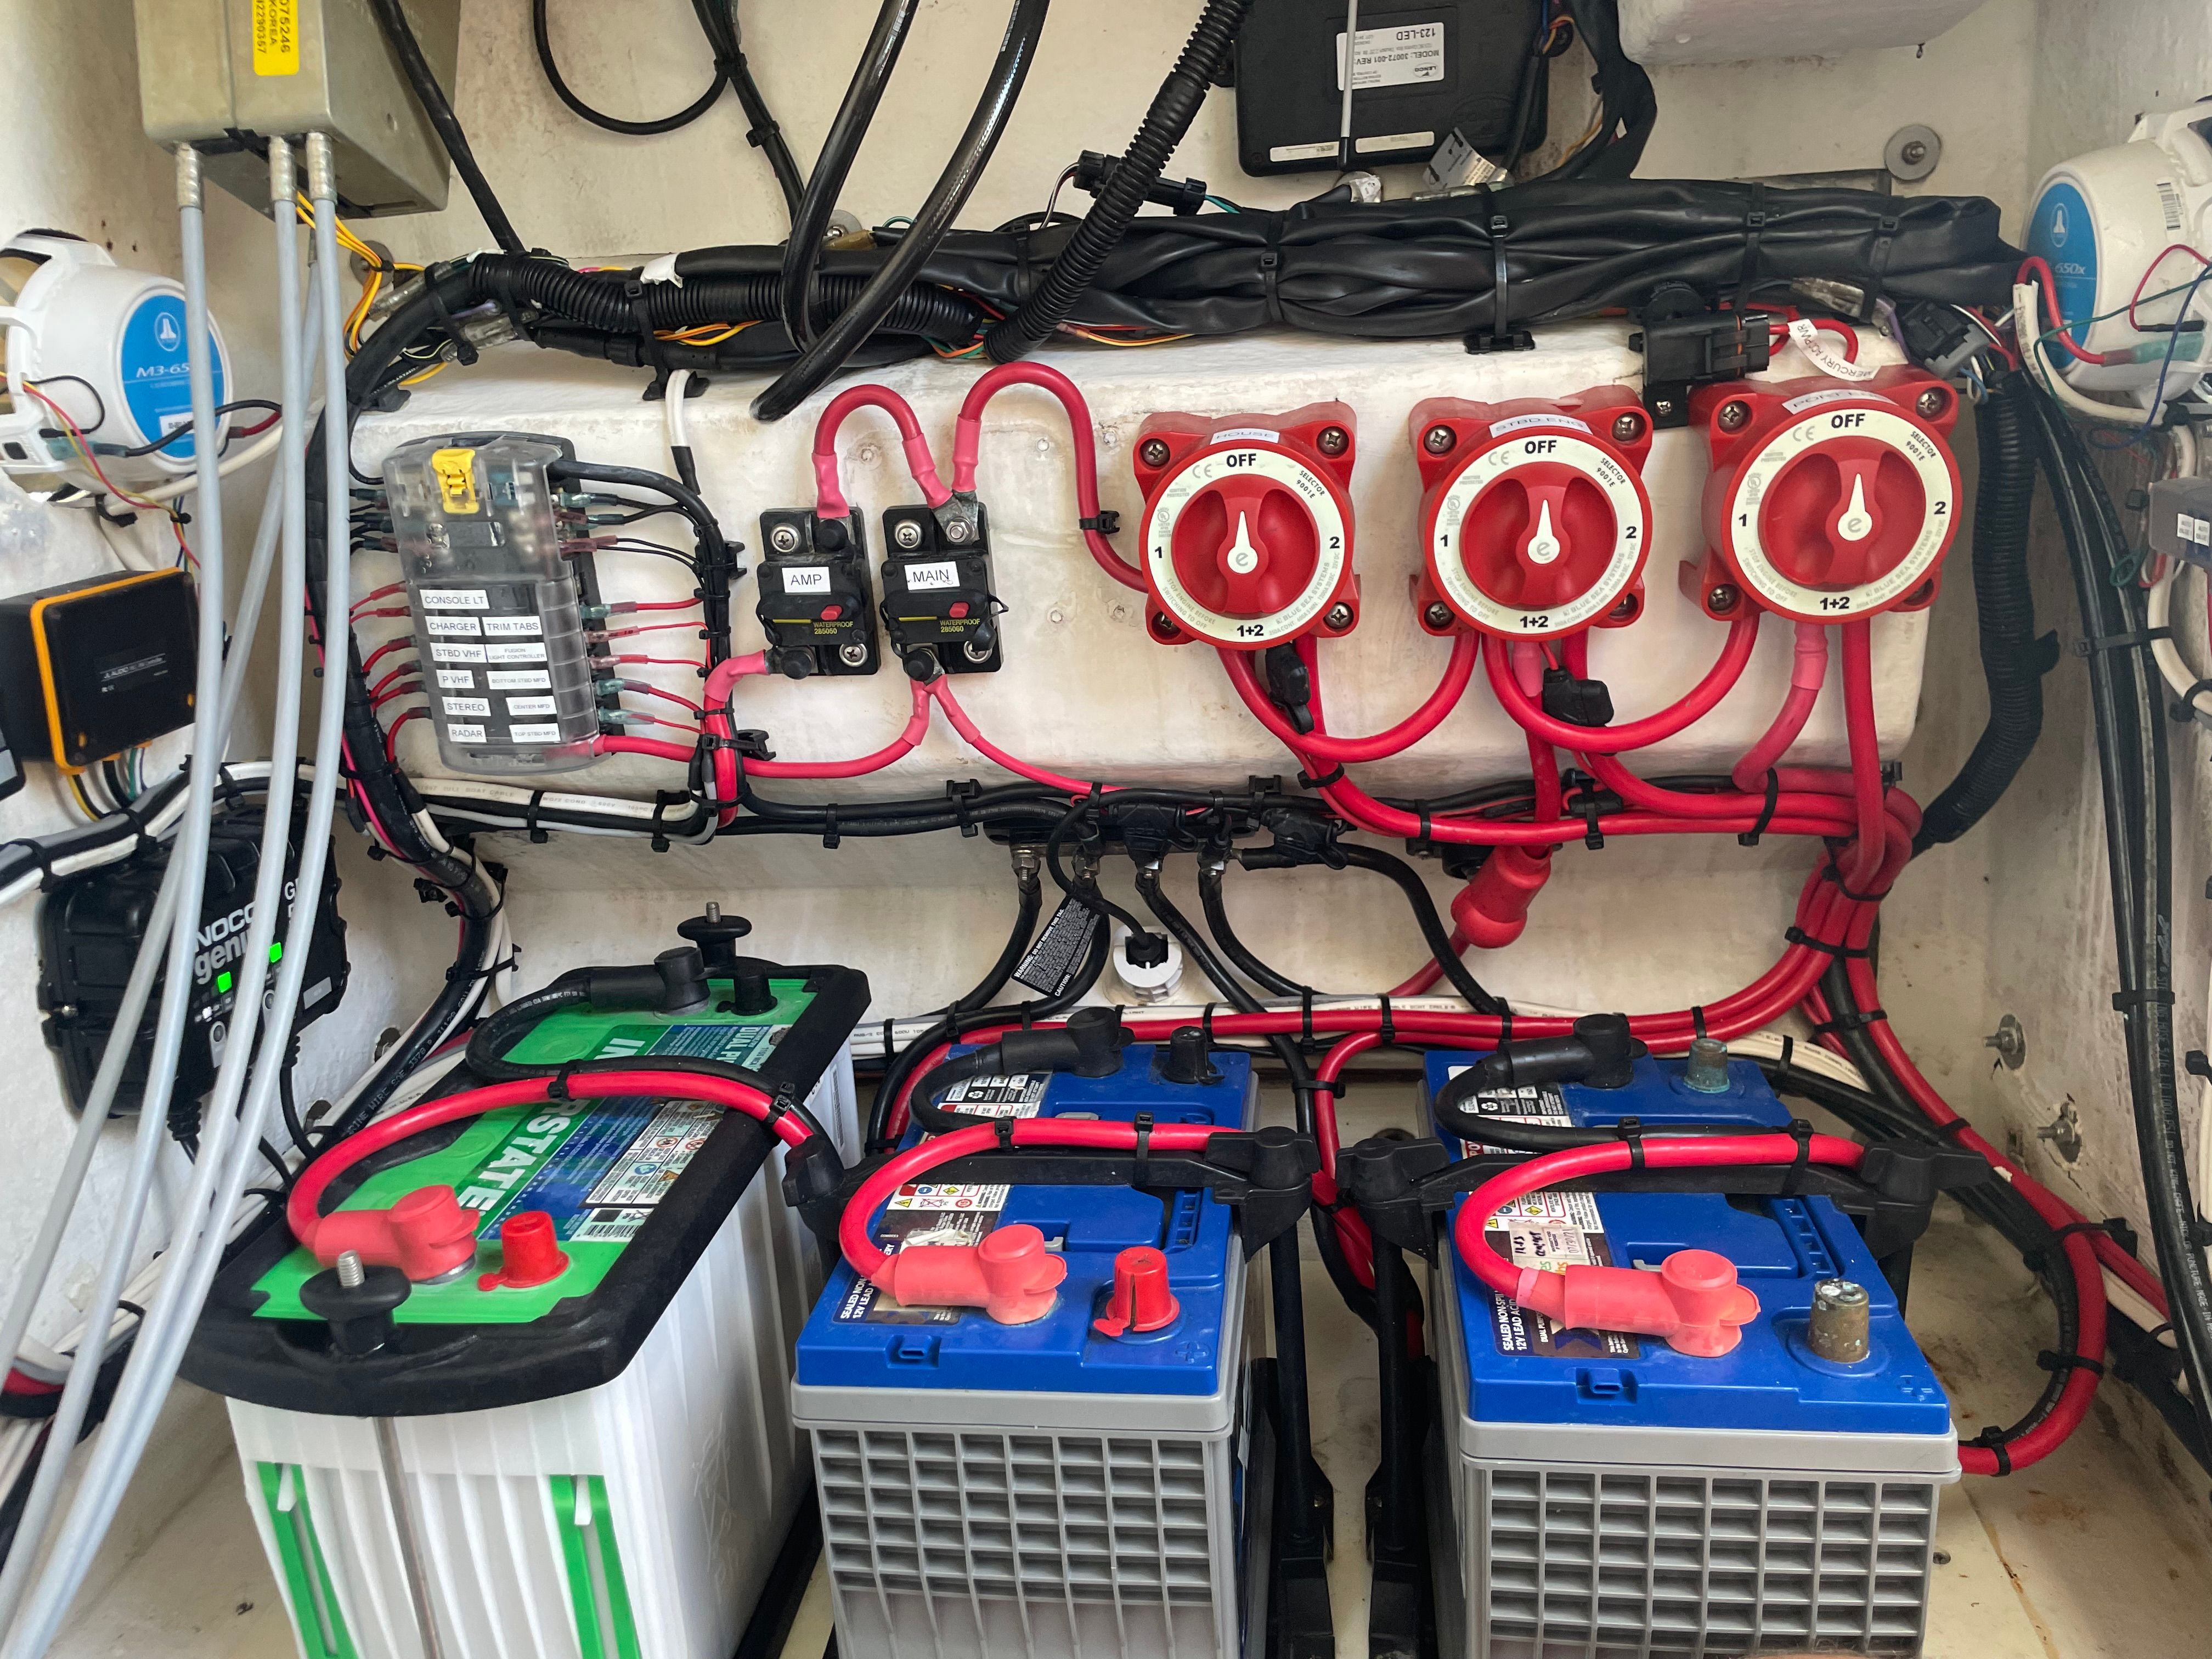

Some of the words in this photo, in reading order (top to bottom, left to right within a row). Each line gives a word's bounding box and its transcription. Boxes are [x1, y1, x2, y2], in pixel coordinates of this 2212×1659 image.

[1396, 28, 1435, 40] 123-LED
[136, 363, 190, 378] M3-65
[1496, 418, 1541, 432] STBD
[1831, 414, 1865, 428] OFF
[1216, 431, 1274, 439] HOUSE
[1525, 440, 1557, 454] OFF
[1906, 441, 1925, 461] 9001E
[1910, 431, 1936, 458] SELECTOR
[1226, 453, 1256, 467] OFF
[1596, 467, 1616, 487] 9001E
[1600, 458, 1626, 484] SELECTOR
[1296, 479, 1316, 499] 9001E
[1299, 470, 1325, 496] SELECTOR
[1933, 502, 1946, 515] 2
[1739, 514, 1747, 527] 1
[1626, 527, 1637, 539] 2
[1329, 537, 1340, 549] 2
[1440, 534, 1448, 547] 1
[1154, 546, 1163, 558] 1
[790, 574, 822, 586] AMP
[912, 568, 950, 583] MAIN
[1283, 607, 1301, 621] BLUE
[1301, 595, 1313, 608] SEA
[1312, 562, 1330, 595] SYSTEMS
[1874, 578, 1896, 594] BLUE
[1163, 587, 1187, 617] SWITCHING
[1187, 614, 1195, 623] TO
[1196, 620, 1207, 630] OFF
[1167, 578, 1178, 592] STOP
[1176, 592, 1194, 612] ENGINE
[1194, 610, 1216, 625] BEFORE
[1571, 599, 1591, 612] BLUE
[1820, 597, 1850, 611] 1+2
[1520, 616, 1548, 628] 1+2
[1237, 625, 1264, 637] 1+2
[447, 703, 486, 711] STEREO
[452, 729, 483, 737] RADAR
[194, 931, 247, 985] geni
[1013, 953, 1034, 978] WARNING:
[1054, 973, 1071, 996] CAUTION:
[725, 1026, 761, 1049] DUAL
[840, 1295, 860, 1318] SEALED
[852, 1305, 865, 1317] 12V
[859, 1287, 874, 1305] LEAD
[1508, 1299, 1520, 1316] ACID
[1511, 1316, 1524, 1335] LEAD
[1499, 1323, 1514, 1351] SEALED
[1539, 1329, 1548, 1342] DUAL
[1515, 1336, 1527, 1350] 12V
